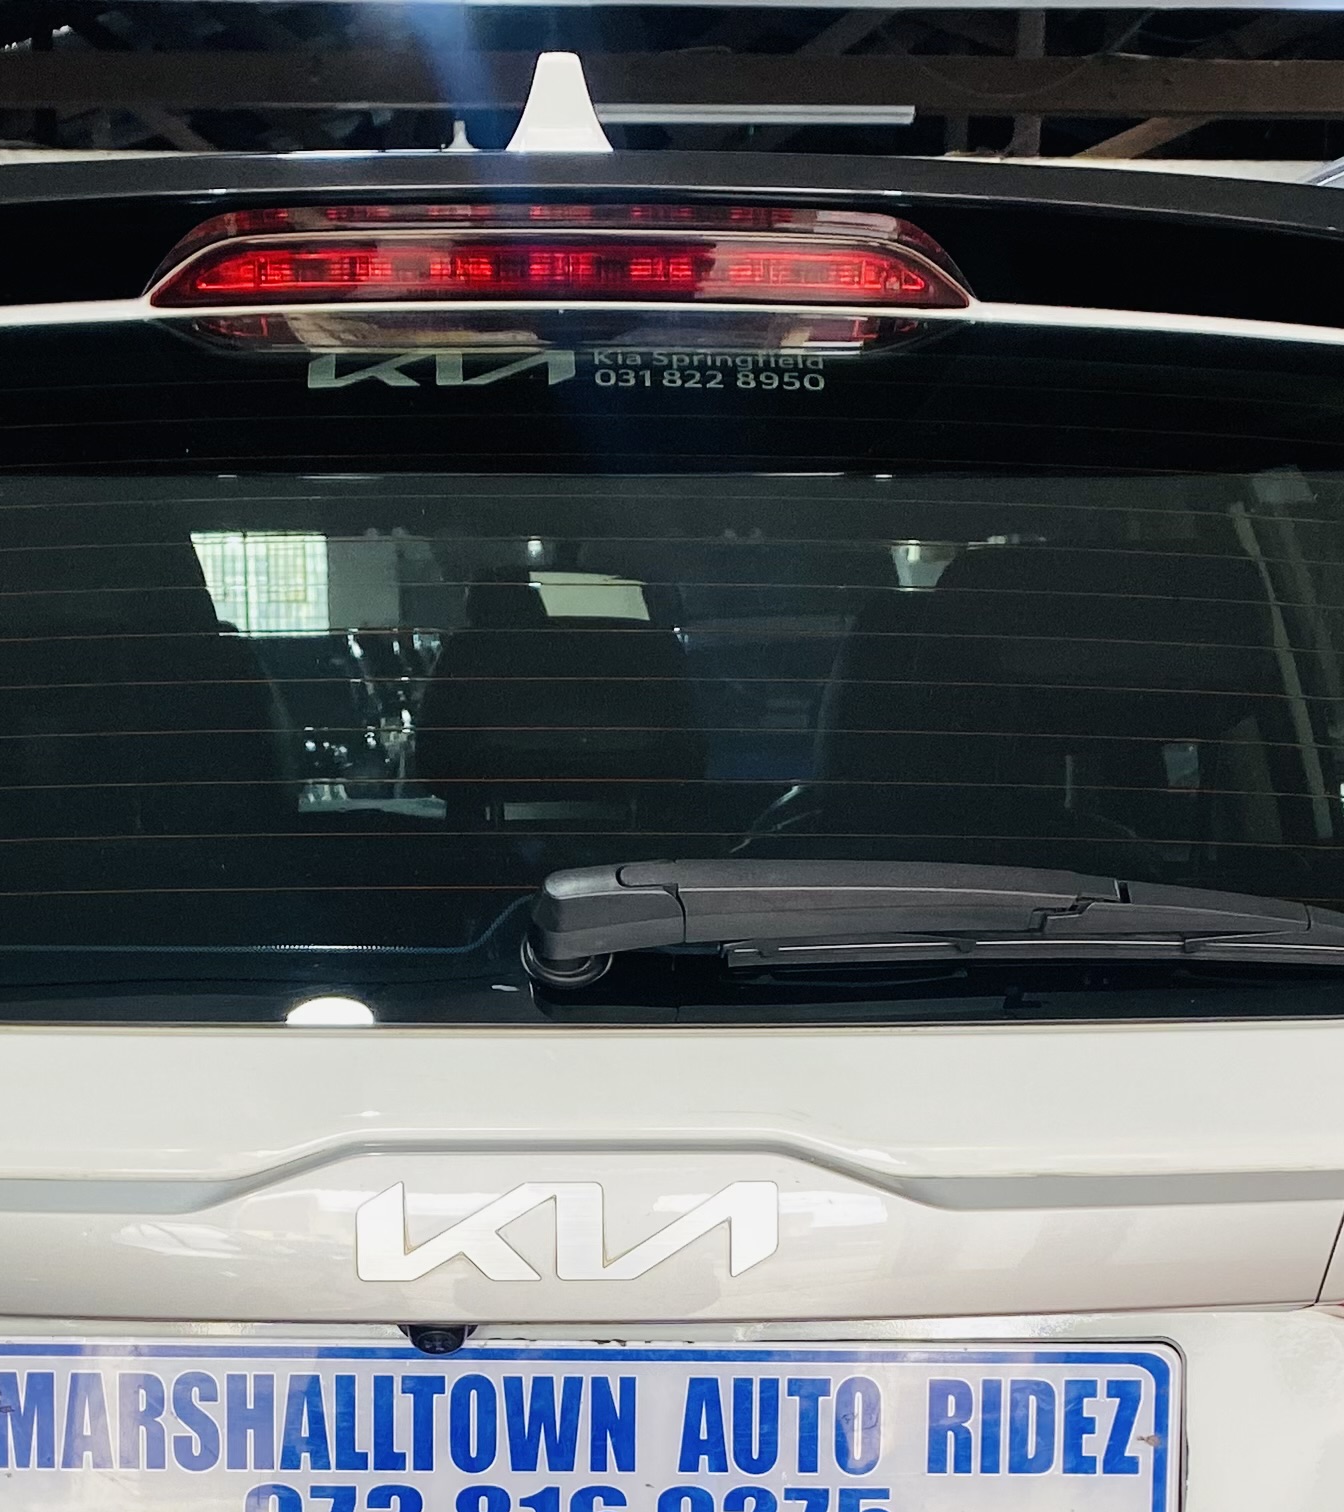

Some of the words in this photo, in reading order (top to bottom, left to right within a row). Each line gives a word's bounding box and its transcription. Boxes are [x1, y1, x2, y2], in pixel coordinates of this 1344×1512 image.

[593, 350, 642, 366] Kia
[652, 350, 825, 372] Springfield
[594, 369, 652, 388] 031
[662, 370, 725, 389] 822
[736, 371, 826, 391] 8950
[356, 1180, 780, 1282] KIA
[676, 1375, 884, 1477] AUTO
[925, 1377, 1147, 1477] RIDEZ
